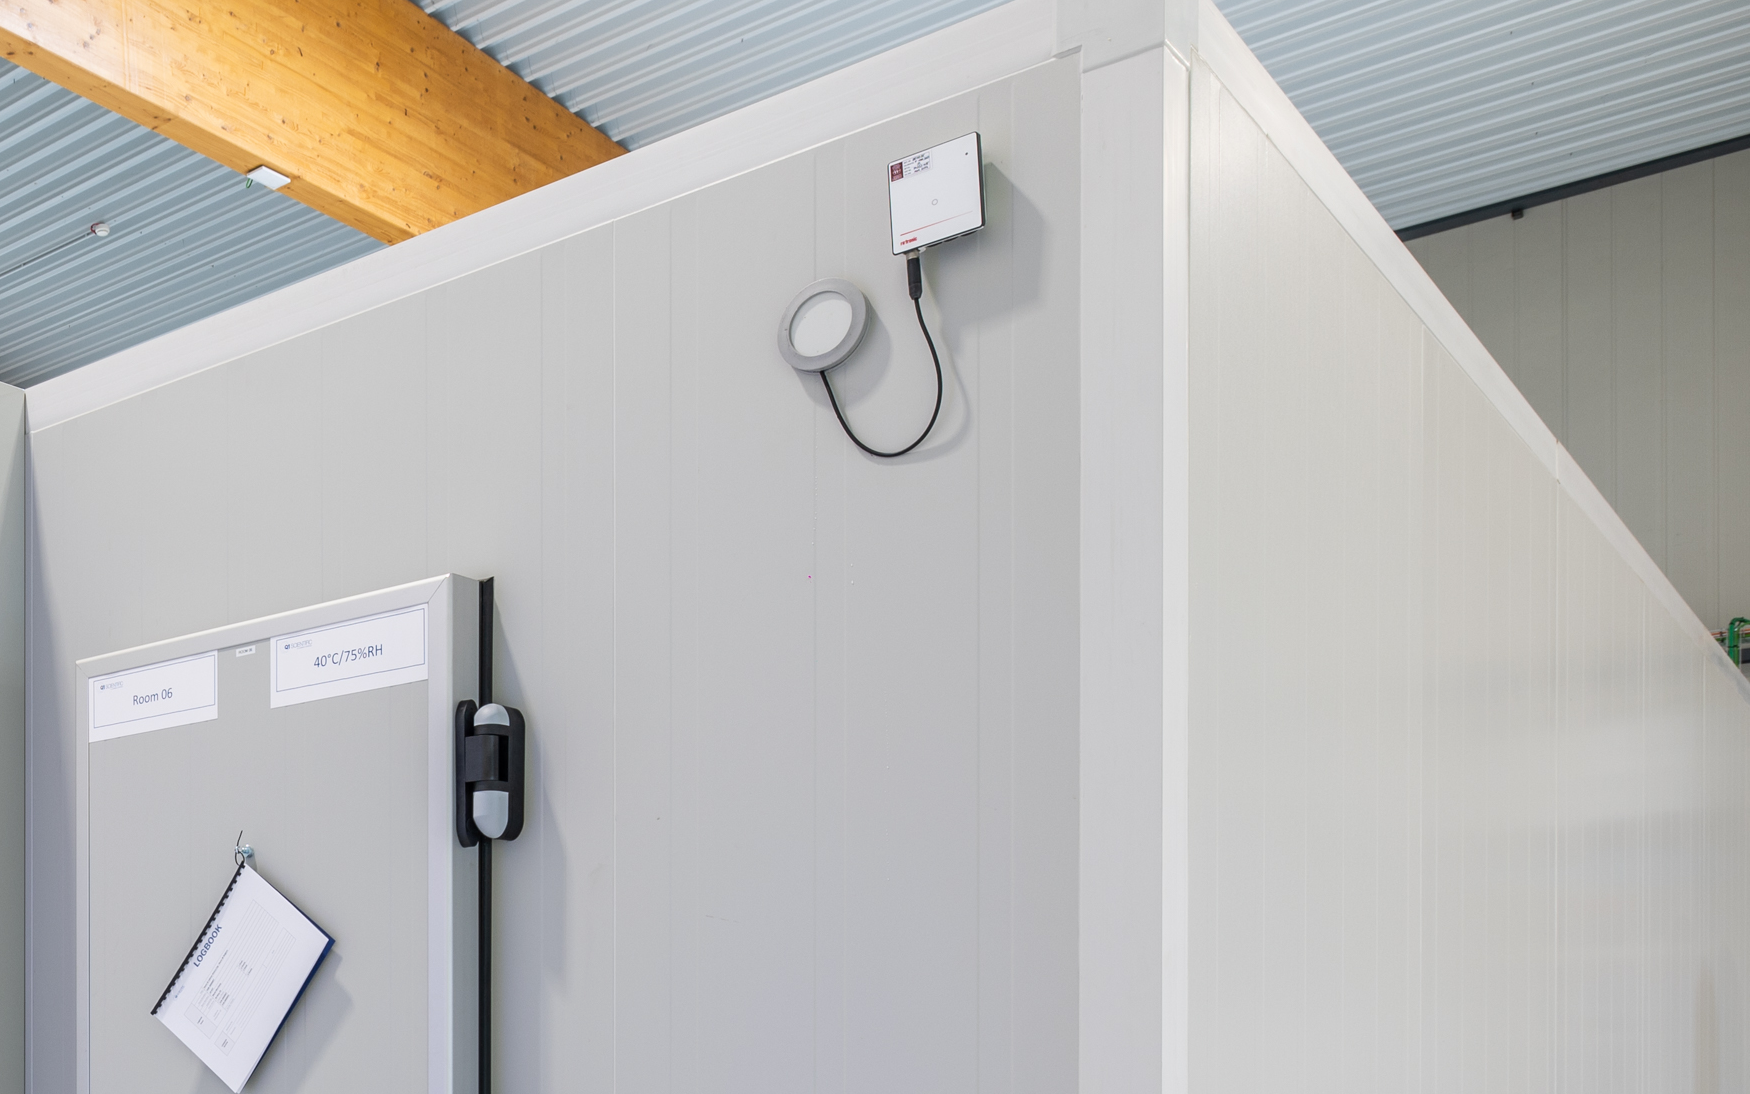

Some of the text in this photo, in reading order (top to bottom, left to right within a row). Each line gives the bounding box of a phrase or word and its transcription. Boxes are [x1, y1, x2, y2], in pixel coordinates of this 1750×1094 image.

[313, 644, 383, 668] 40°C/75%RH
[132, 687, 173, 706] Room 06
[193, 924, 223, 968] LOGBOOK
